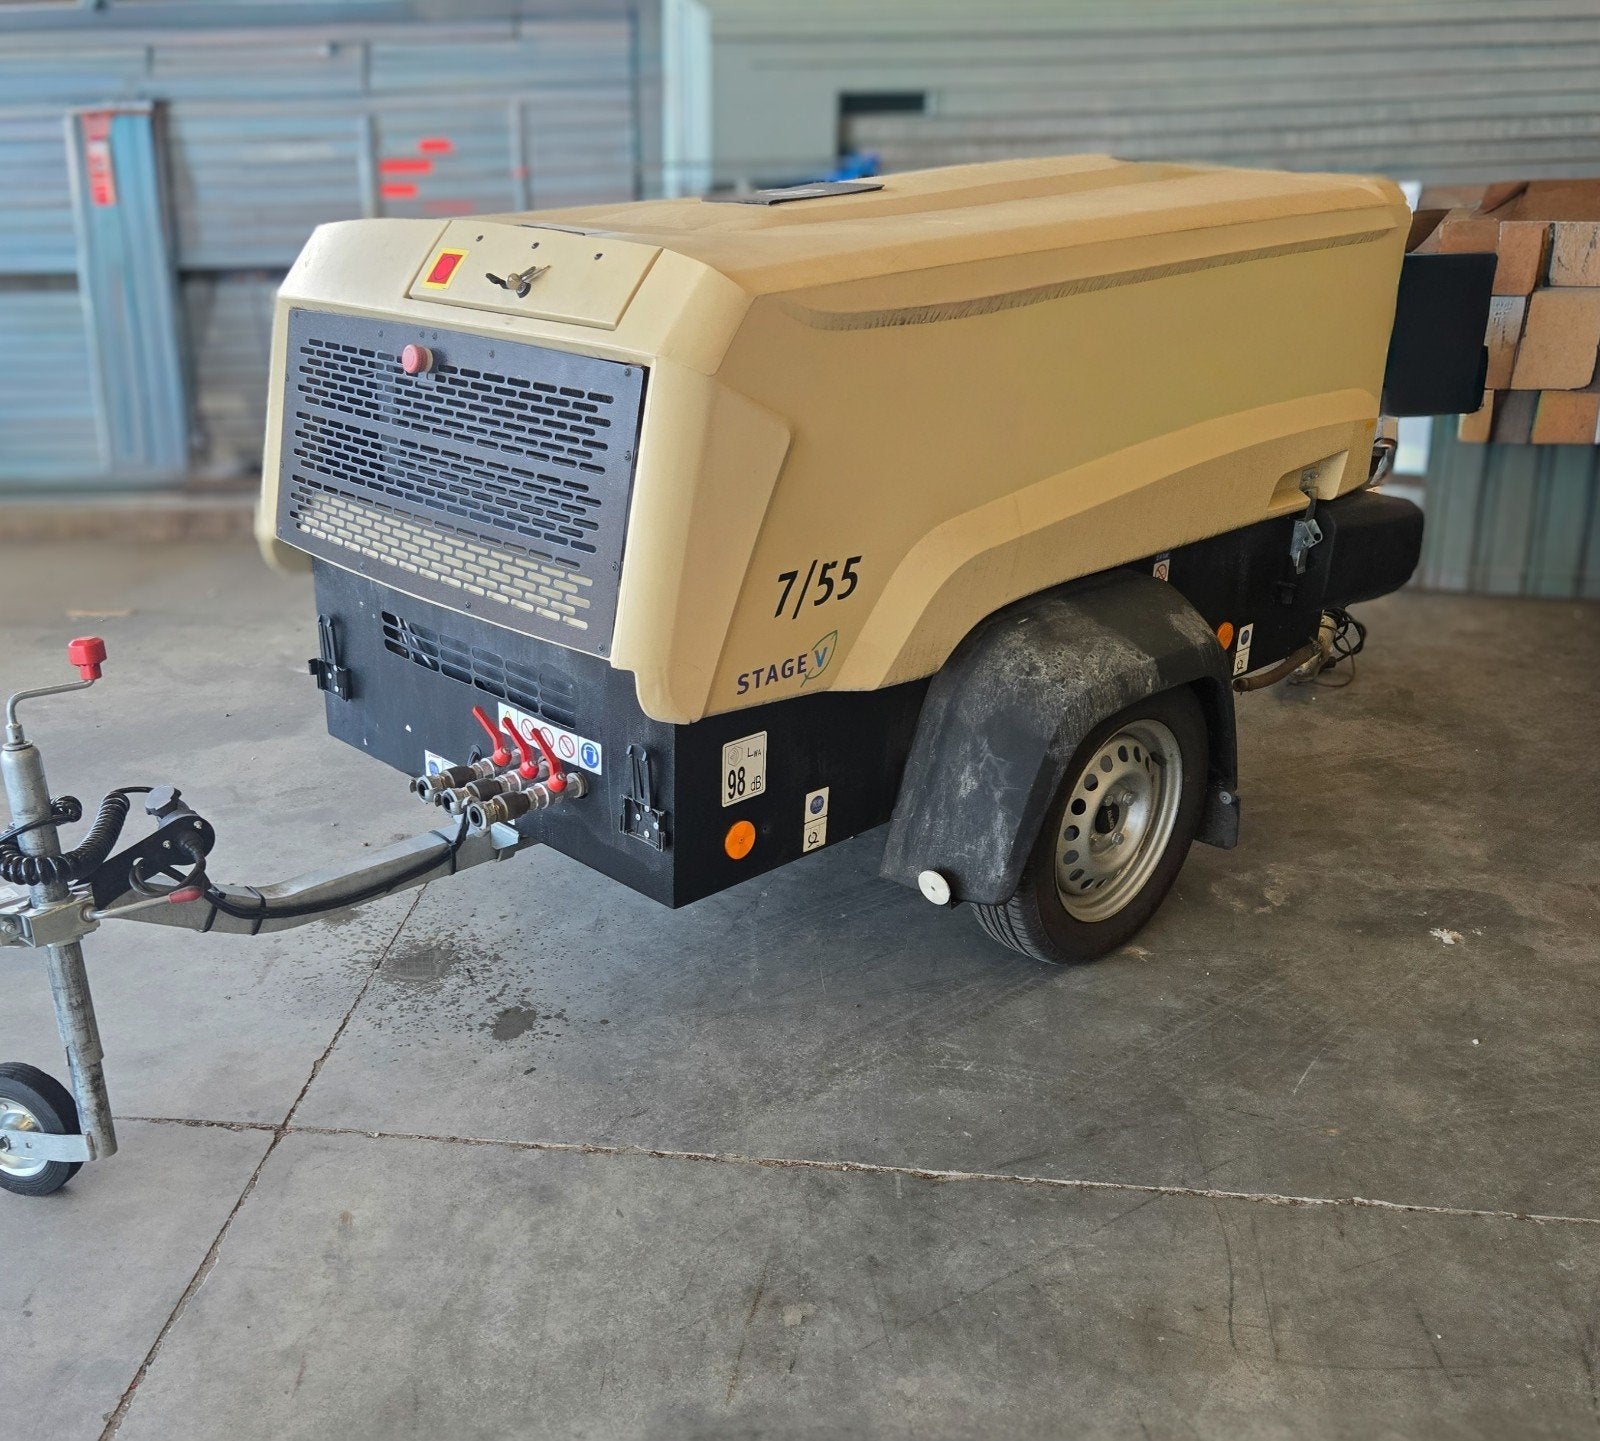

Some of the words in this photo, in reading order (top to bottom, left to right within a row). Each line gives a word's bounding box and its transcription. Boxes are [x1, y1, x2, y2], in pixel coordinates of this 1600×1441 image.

[774, 555, 862, 620] 7/55
[736, 653, 808, 695] STAGE
[814, 646, 829, 668] V
[727, 766, 746, 800] 98
[750, 774, 762, 792] dB
